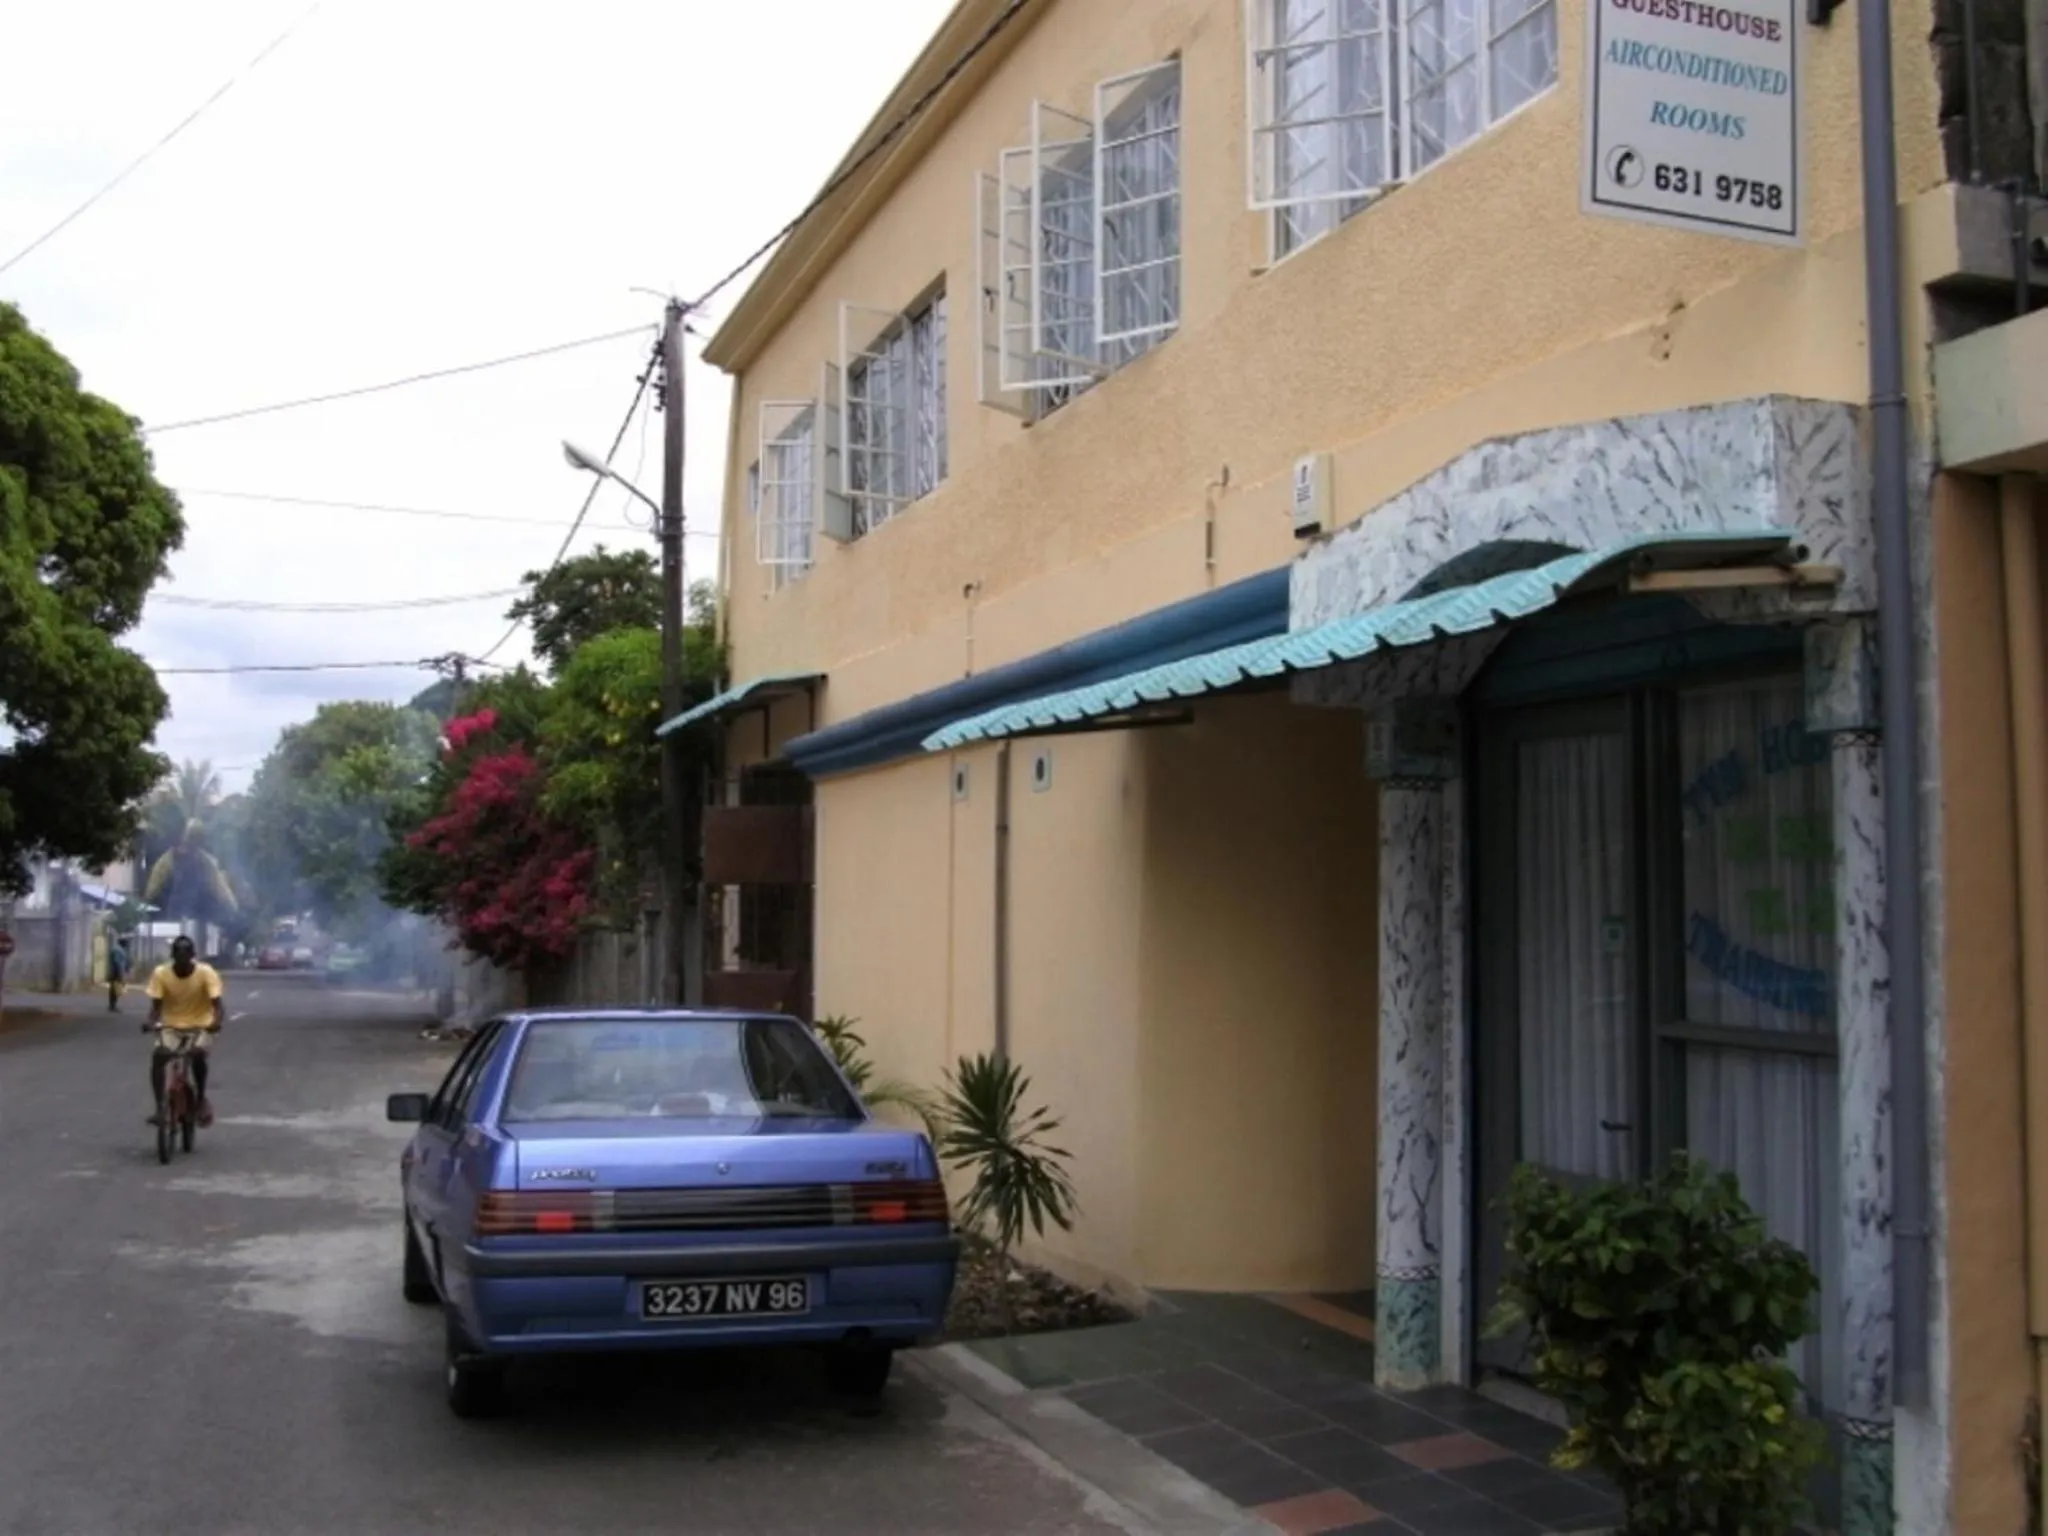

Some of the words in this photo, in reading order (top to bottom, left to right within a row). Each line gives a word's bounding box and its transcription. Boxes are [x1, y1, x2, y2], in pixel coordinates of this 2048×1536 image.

[1605, 38, 1788, 96] AIRCONDITIONED
[1650, 101, 1746, 140] ROOMS
[1654, 163, 1702, 197] 631
[1715, 174, 1783, 211] 9758
[648, 1284, 720, 1314] 3237
[725, 1283, 762, 1312] NV
[768, 1282, 804, 1310] 96
